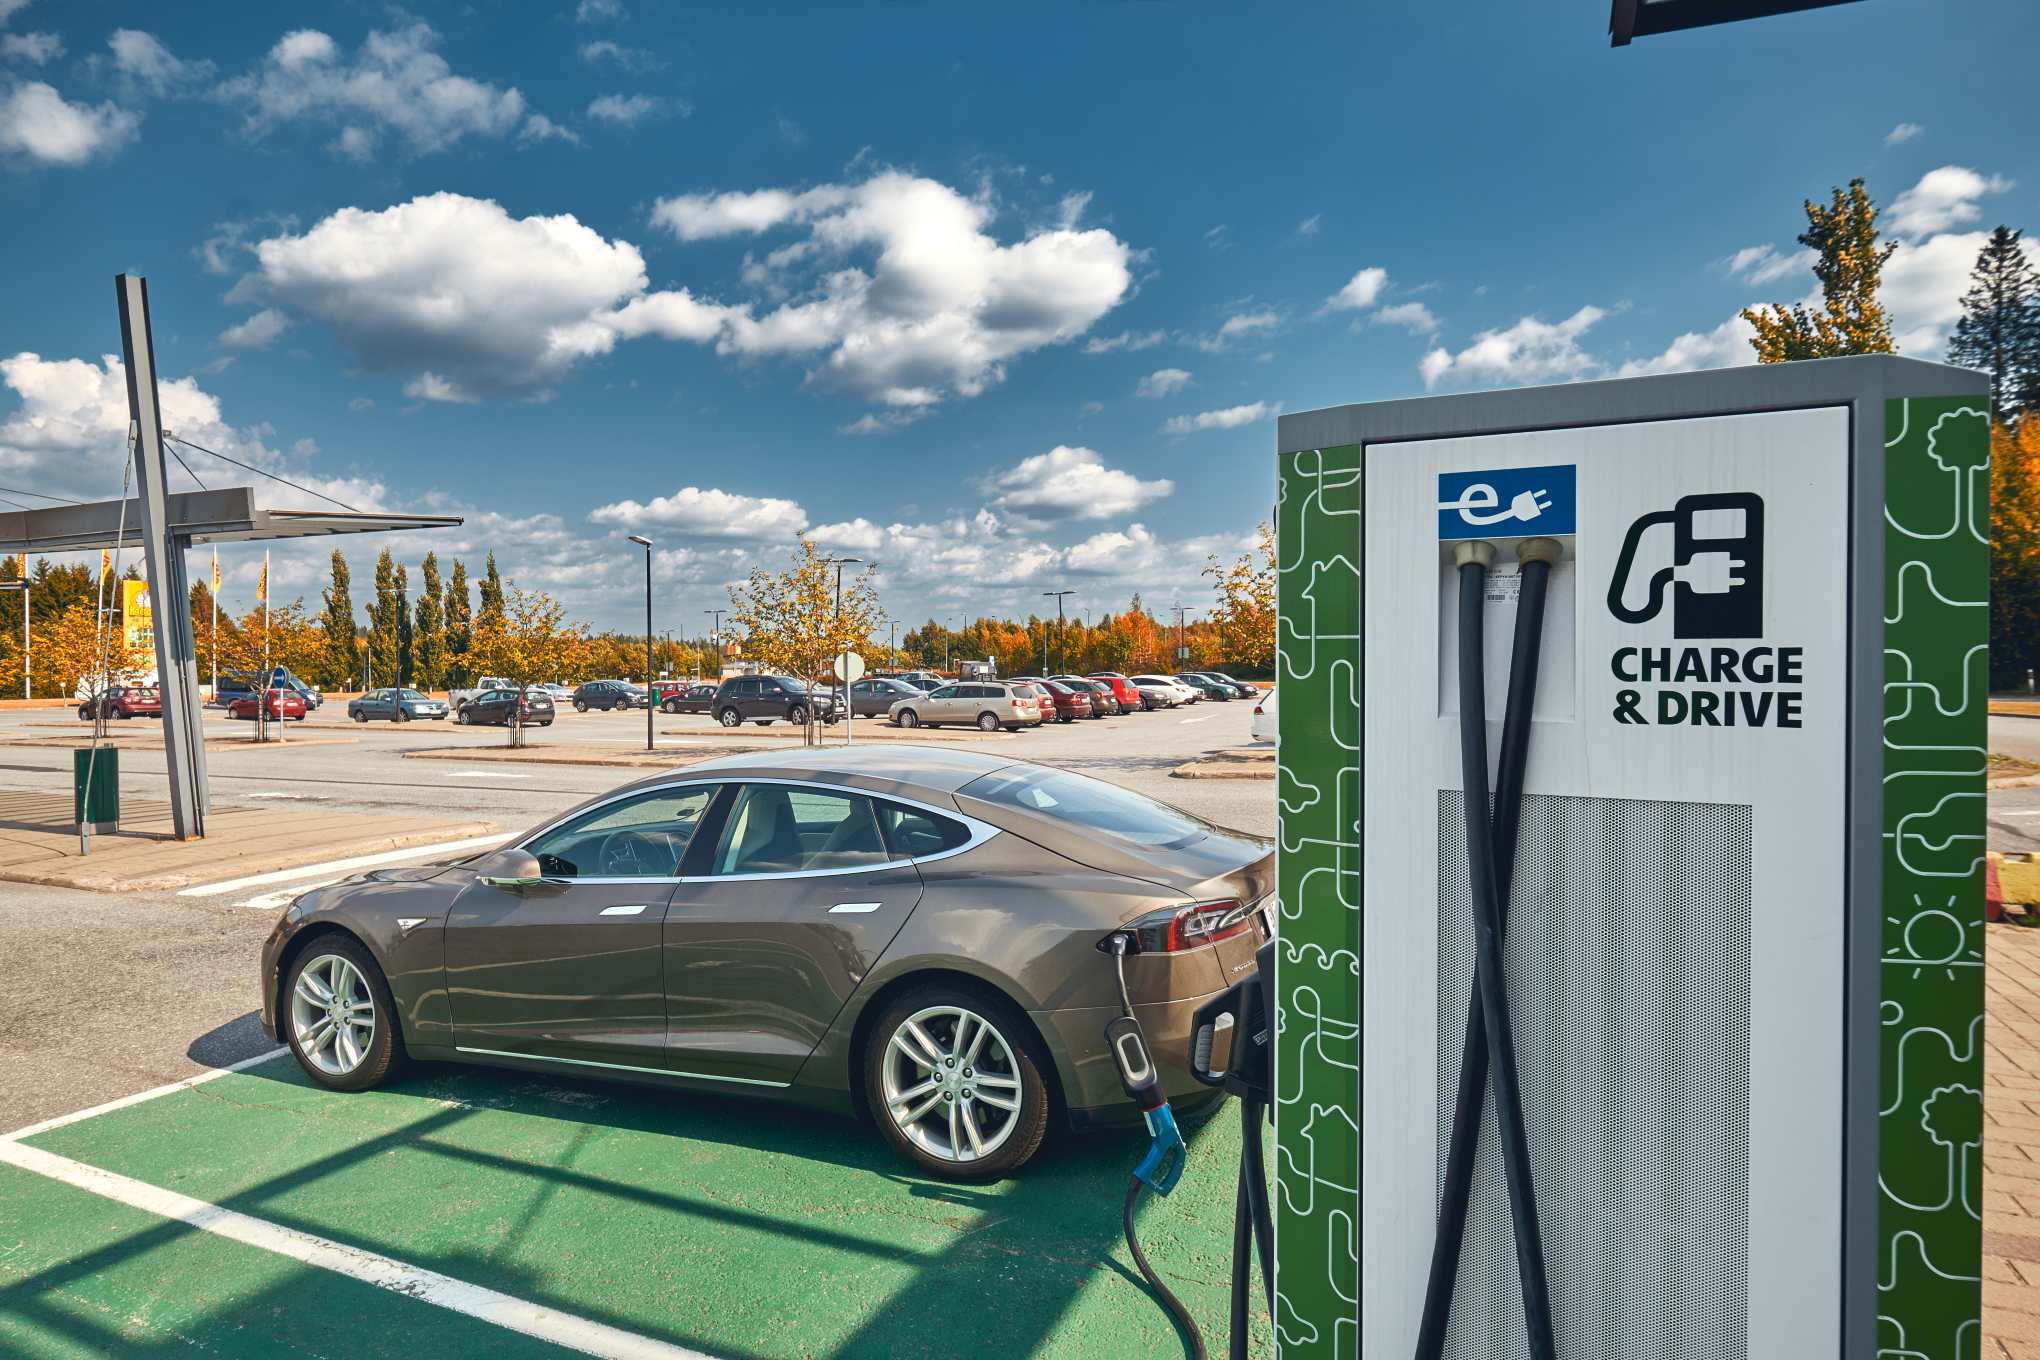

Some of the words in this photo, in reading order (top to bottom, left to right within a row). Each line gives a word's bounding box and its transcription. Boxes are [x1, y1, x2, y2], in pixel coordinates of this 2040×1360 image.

[1610, 646, 1803, 683] CHARGE
[1612, 690, 1650, 725] &
[1657, 690, 1803, 728] DRIVE
